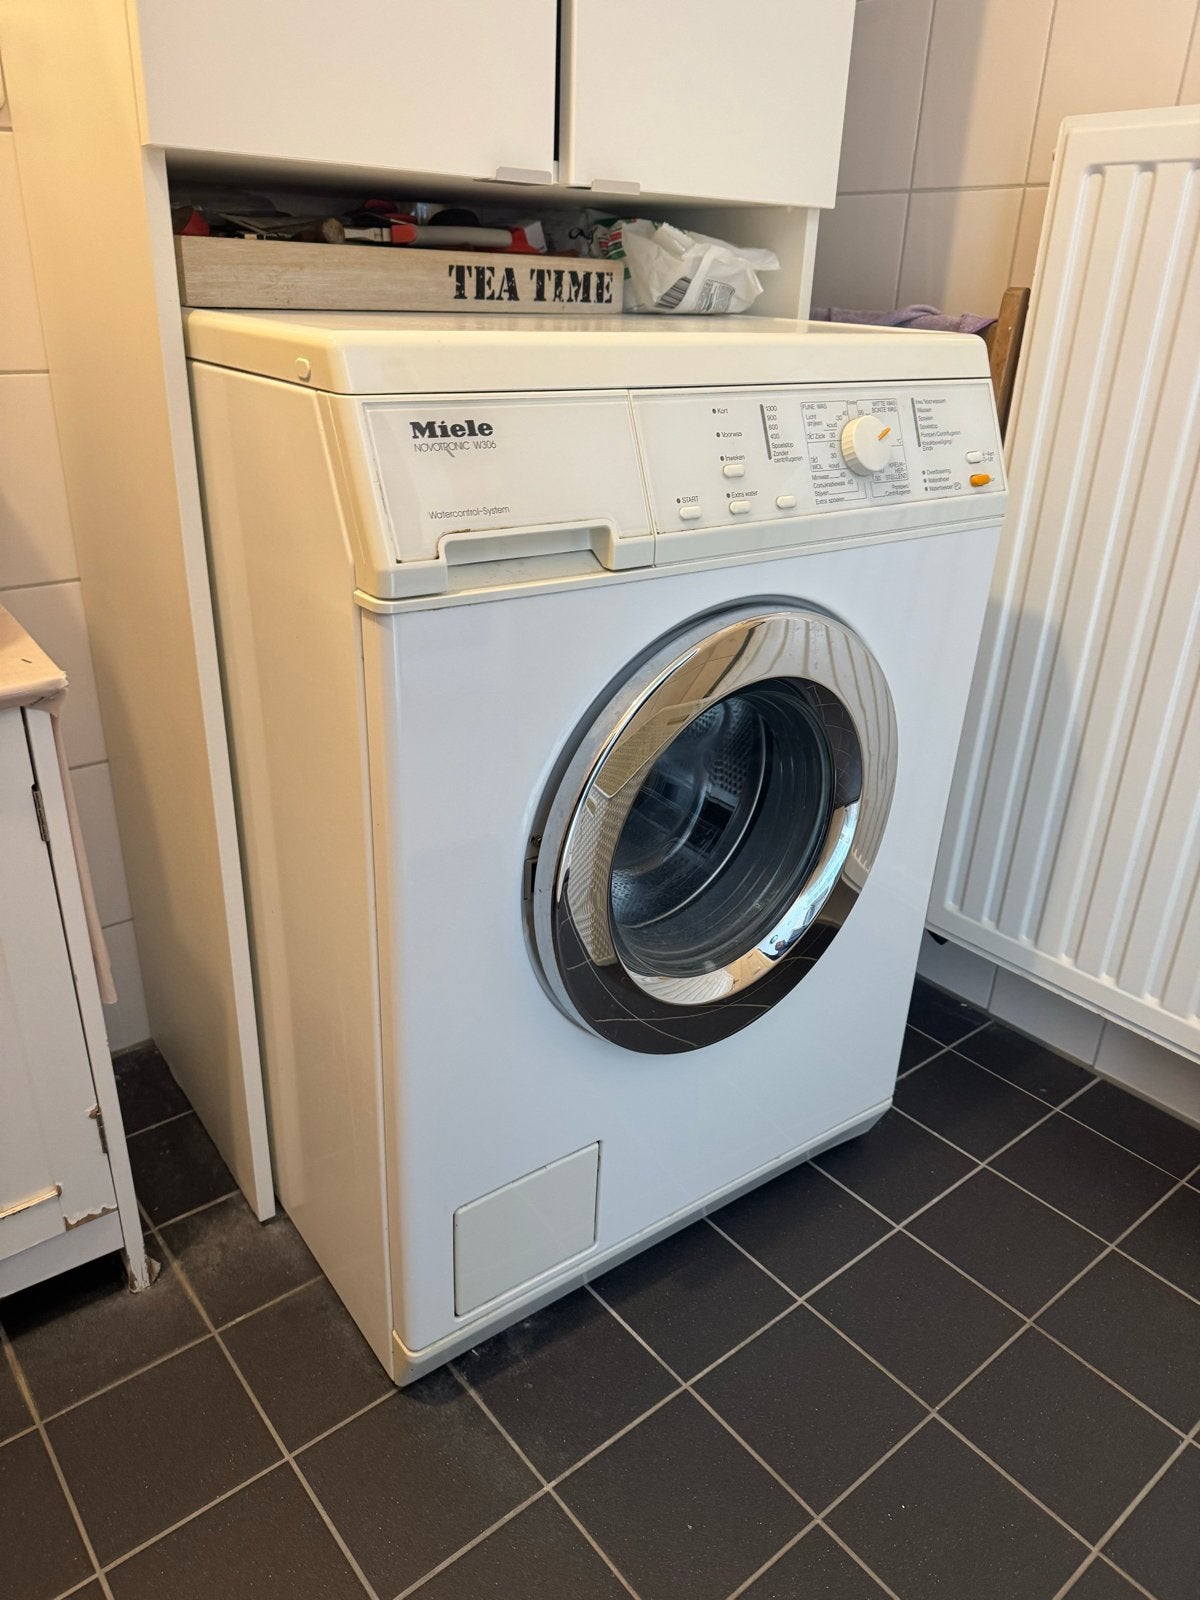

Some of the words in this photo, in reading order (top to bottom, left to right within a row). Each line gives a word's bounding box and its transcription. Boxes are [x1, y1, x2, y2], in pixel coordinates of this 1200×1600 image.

[449, 264, 520, 302] TEA
[530, 267, 614, 304] TIME
[409, 419, 494, 439] Miele
[413, 441, 471, 458] NOVOTRONIC
[473, 440, 497, 450] W306
[682, 495, 699, 503] START
[428, 506, 511, 520] Watercontrol-System
